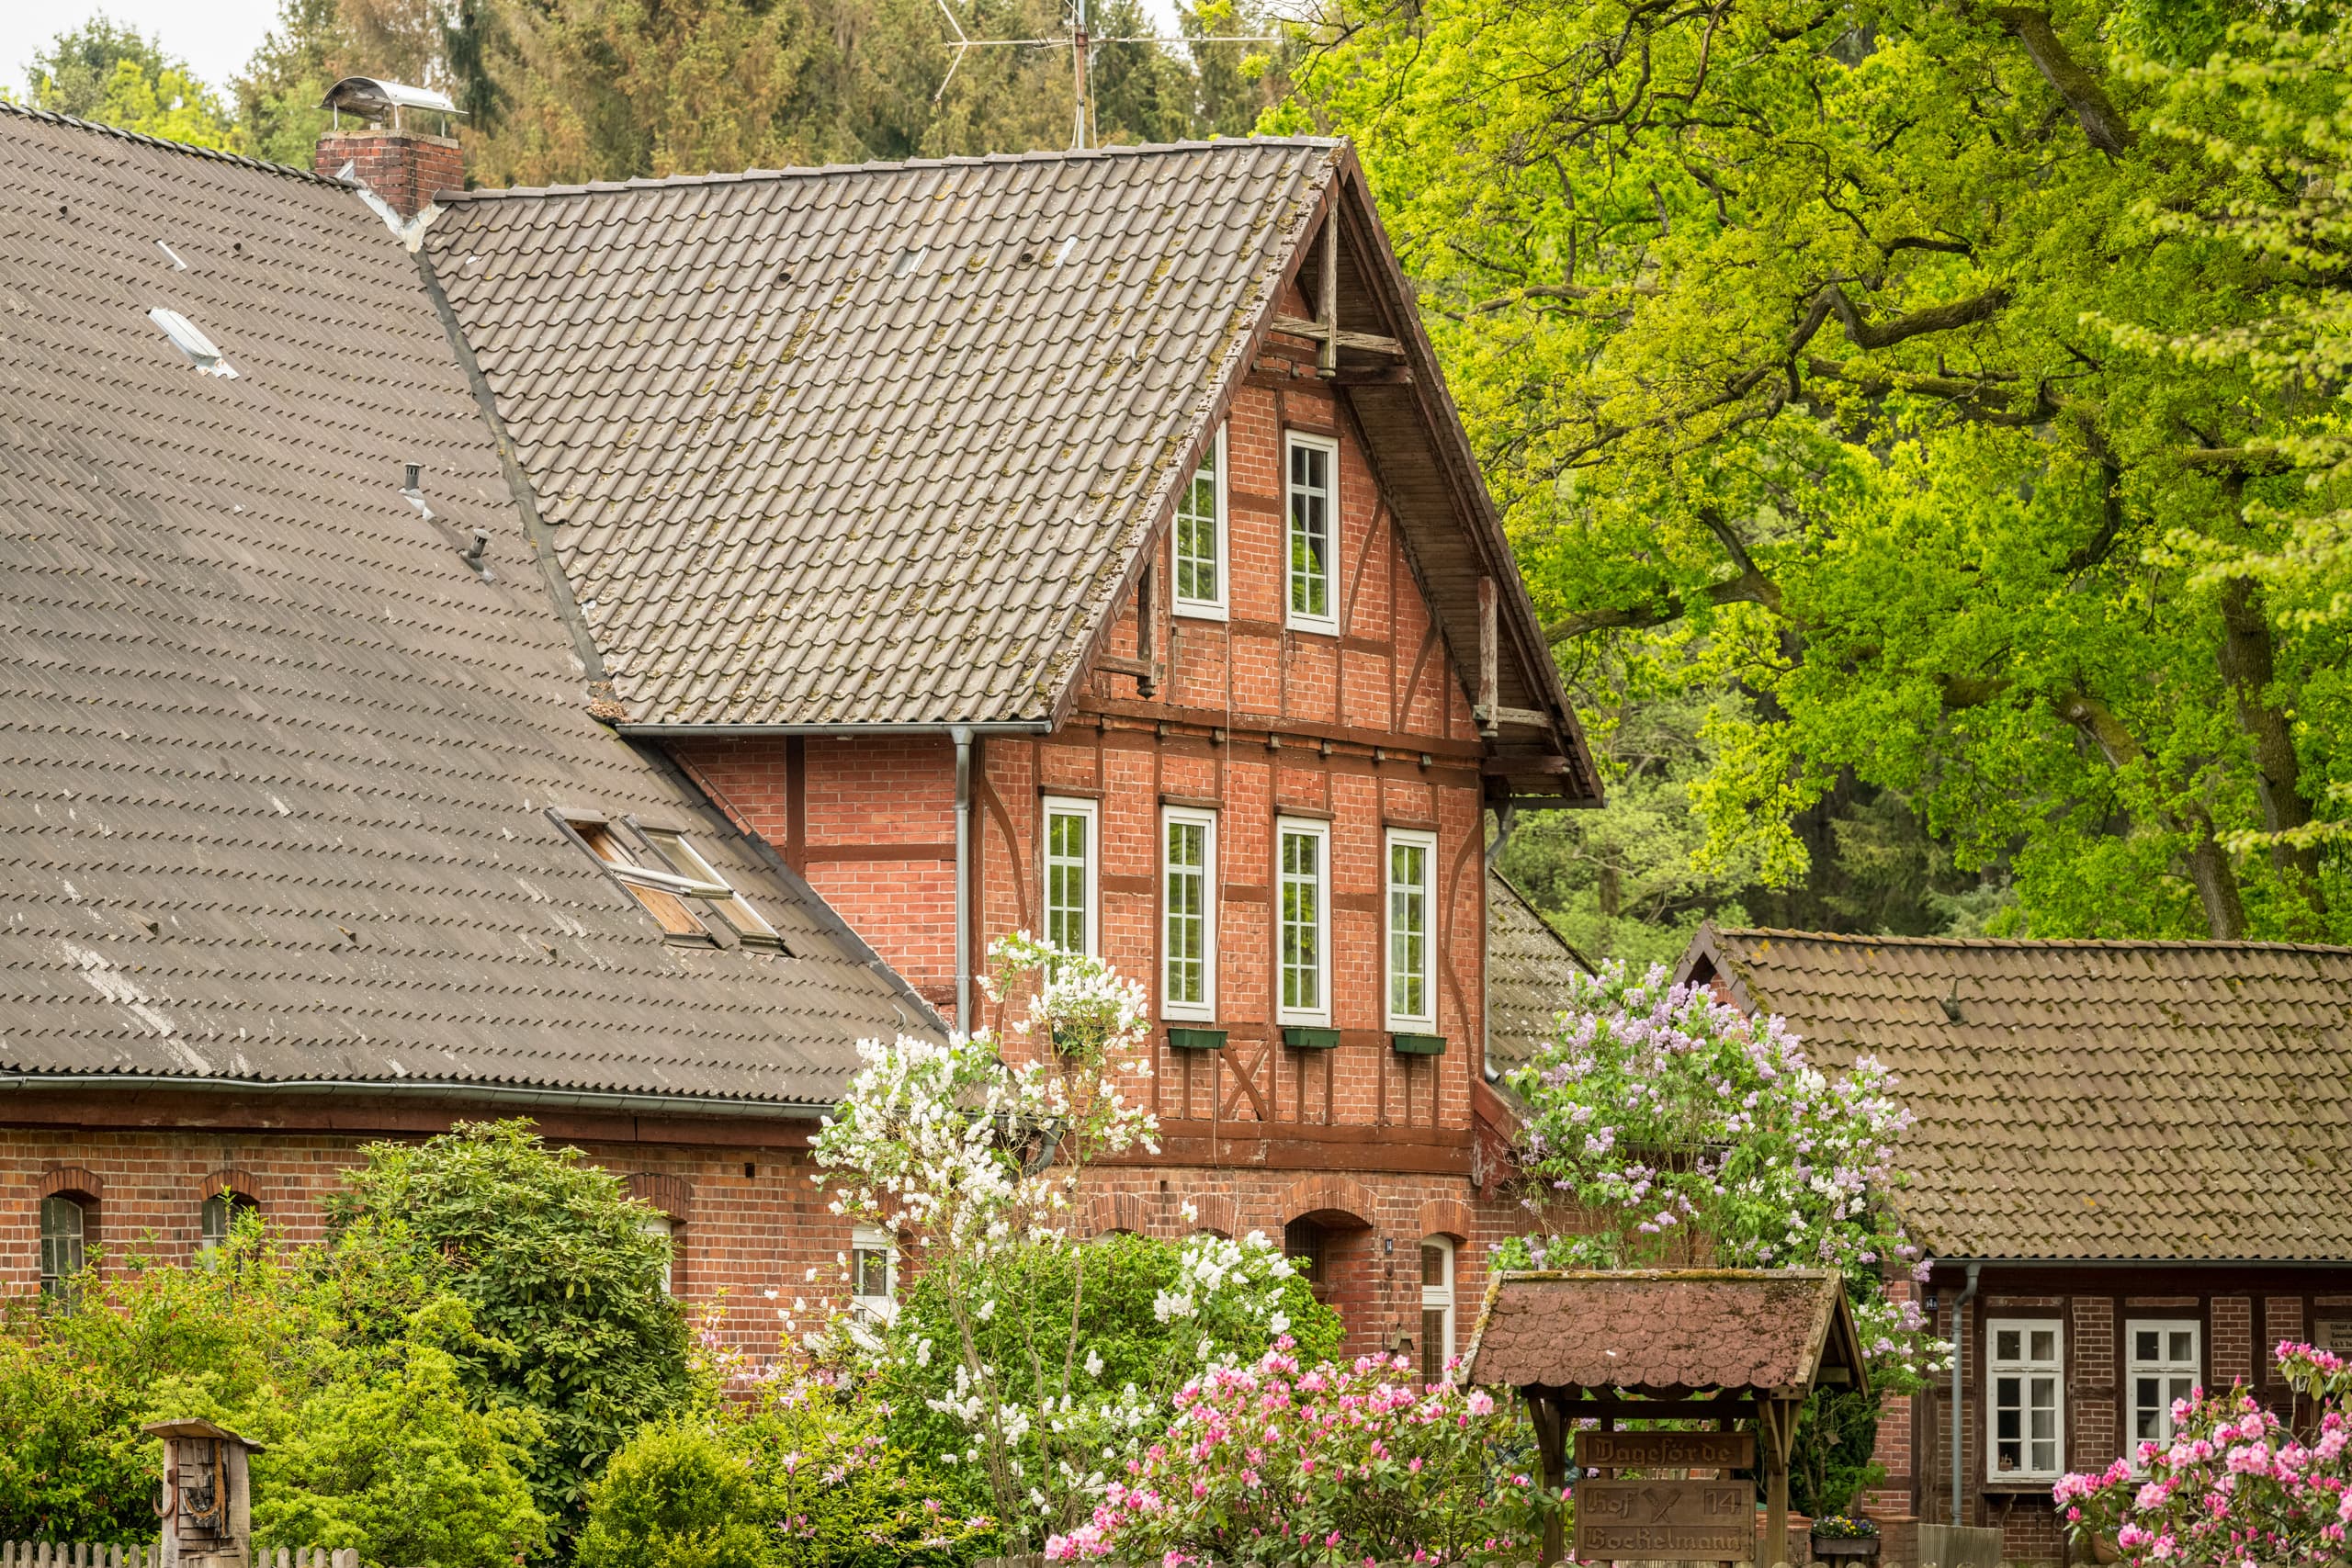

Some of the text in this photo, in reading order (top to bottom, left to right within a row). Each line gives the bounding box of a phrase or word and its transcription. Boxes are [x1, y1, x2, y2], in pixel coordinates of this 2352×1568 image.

[1594, 1438, 1735, 1466] Dageförde
[1587, 1490, 1740, 1519] Hof 14
[1586, 1528, 1742, 1551] Bockelmann
